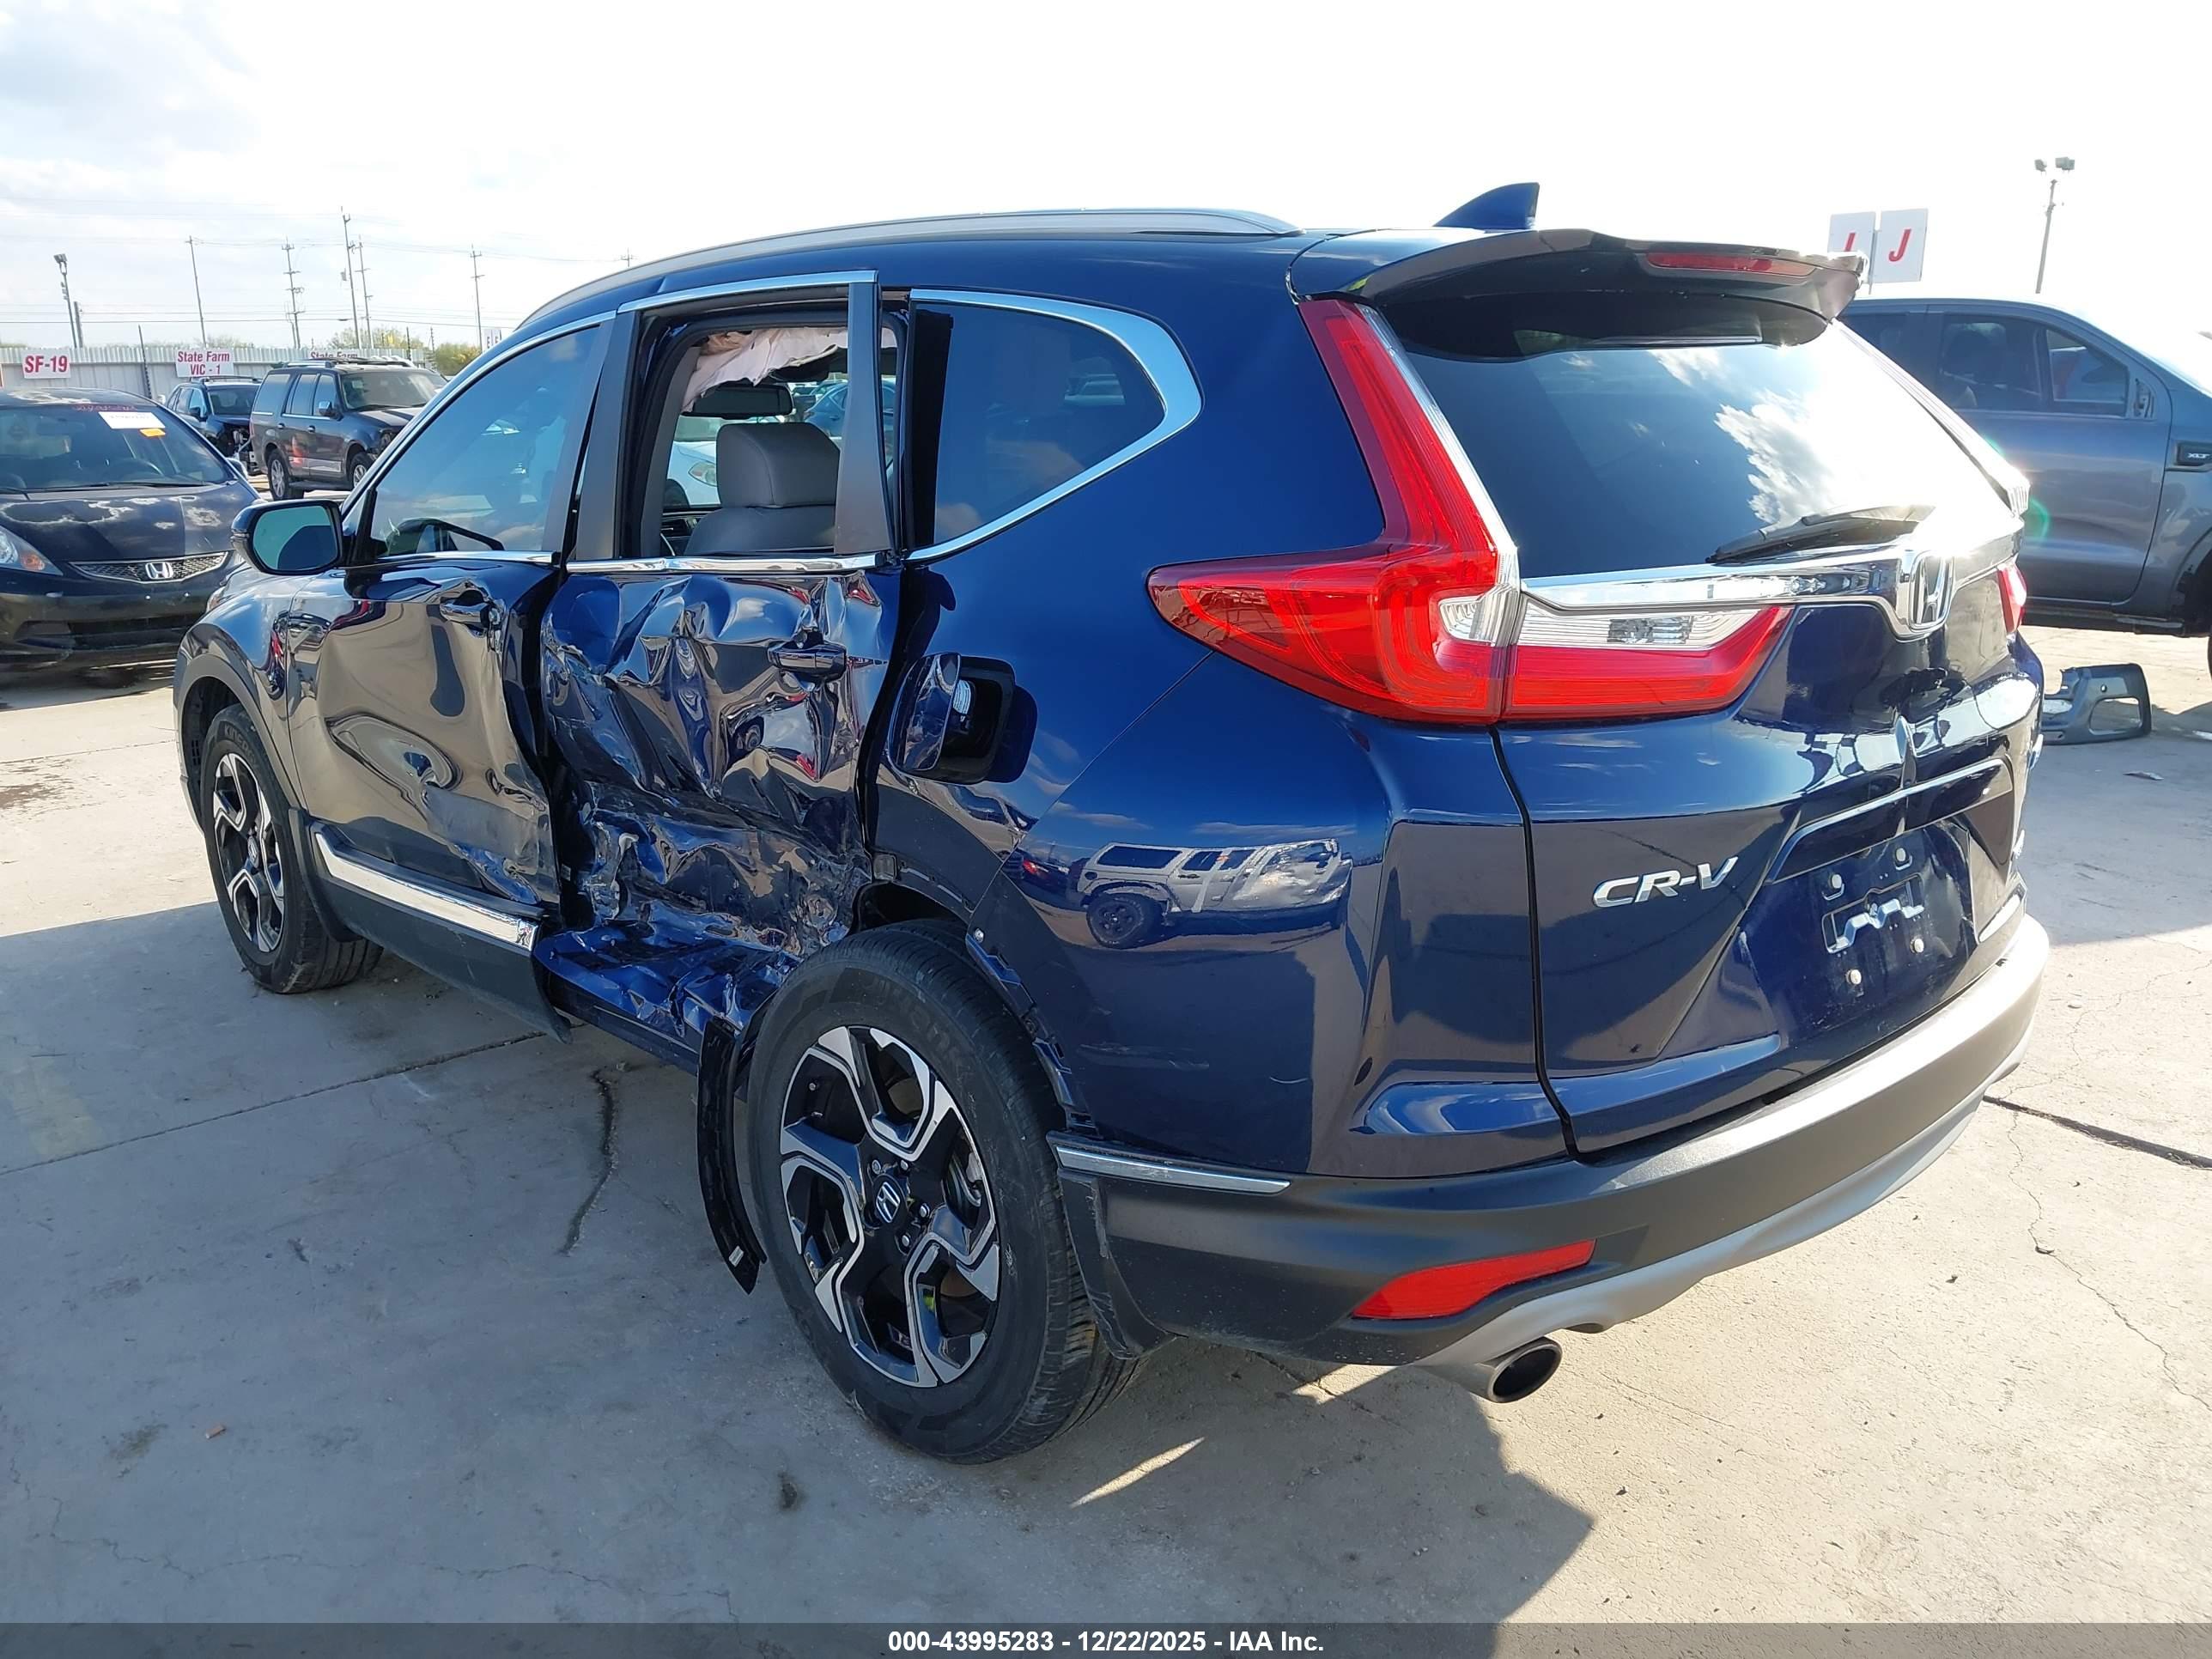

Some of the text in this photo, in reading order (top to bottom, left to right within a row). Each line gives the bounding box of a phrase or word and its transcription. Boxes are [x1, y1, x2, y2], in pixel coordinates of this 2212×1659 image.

[1888, 228, 1912, 262] J
[24, 355, 68, 374] SF-19
[178, 350, 230, 362] State Farm
[190, 363, 206, 375] VIC
[216, 364, 221, 374] 1
[1592, 856, 1739, 908] CR-V
